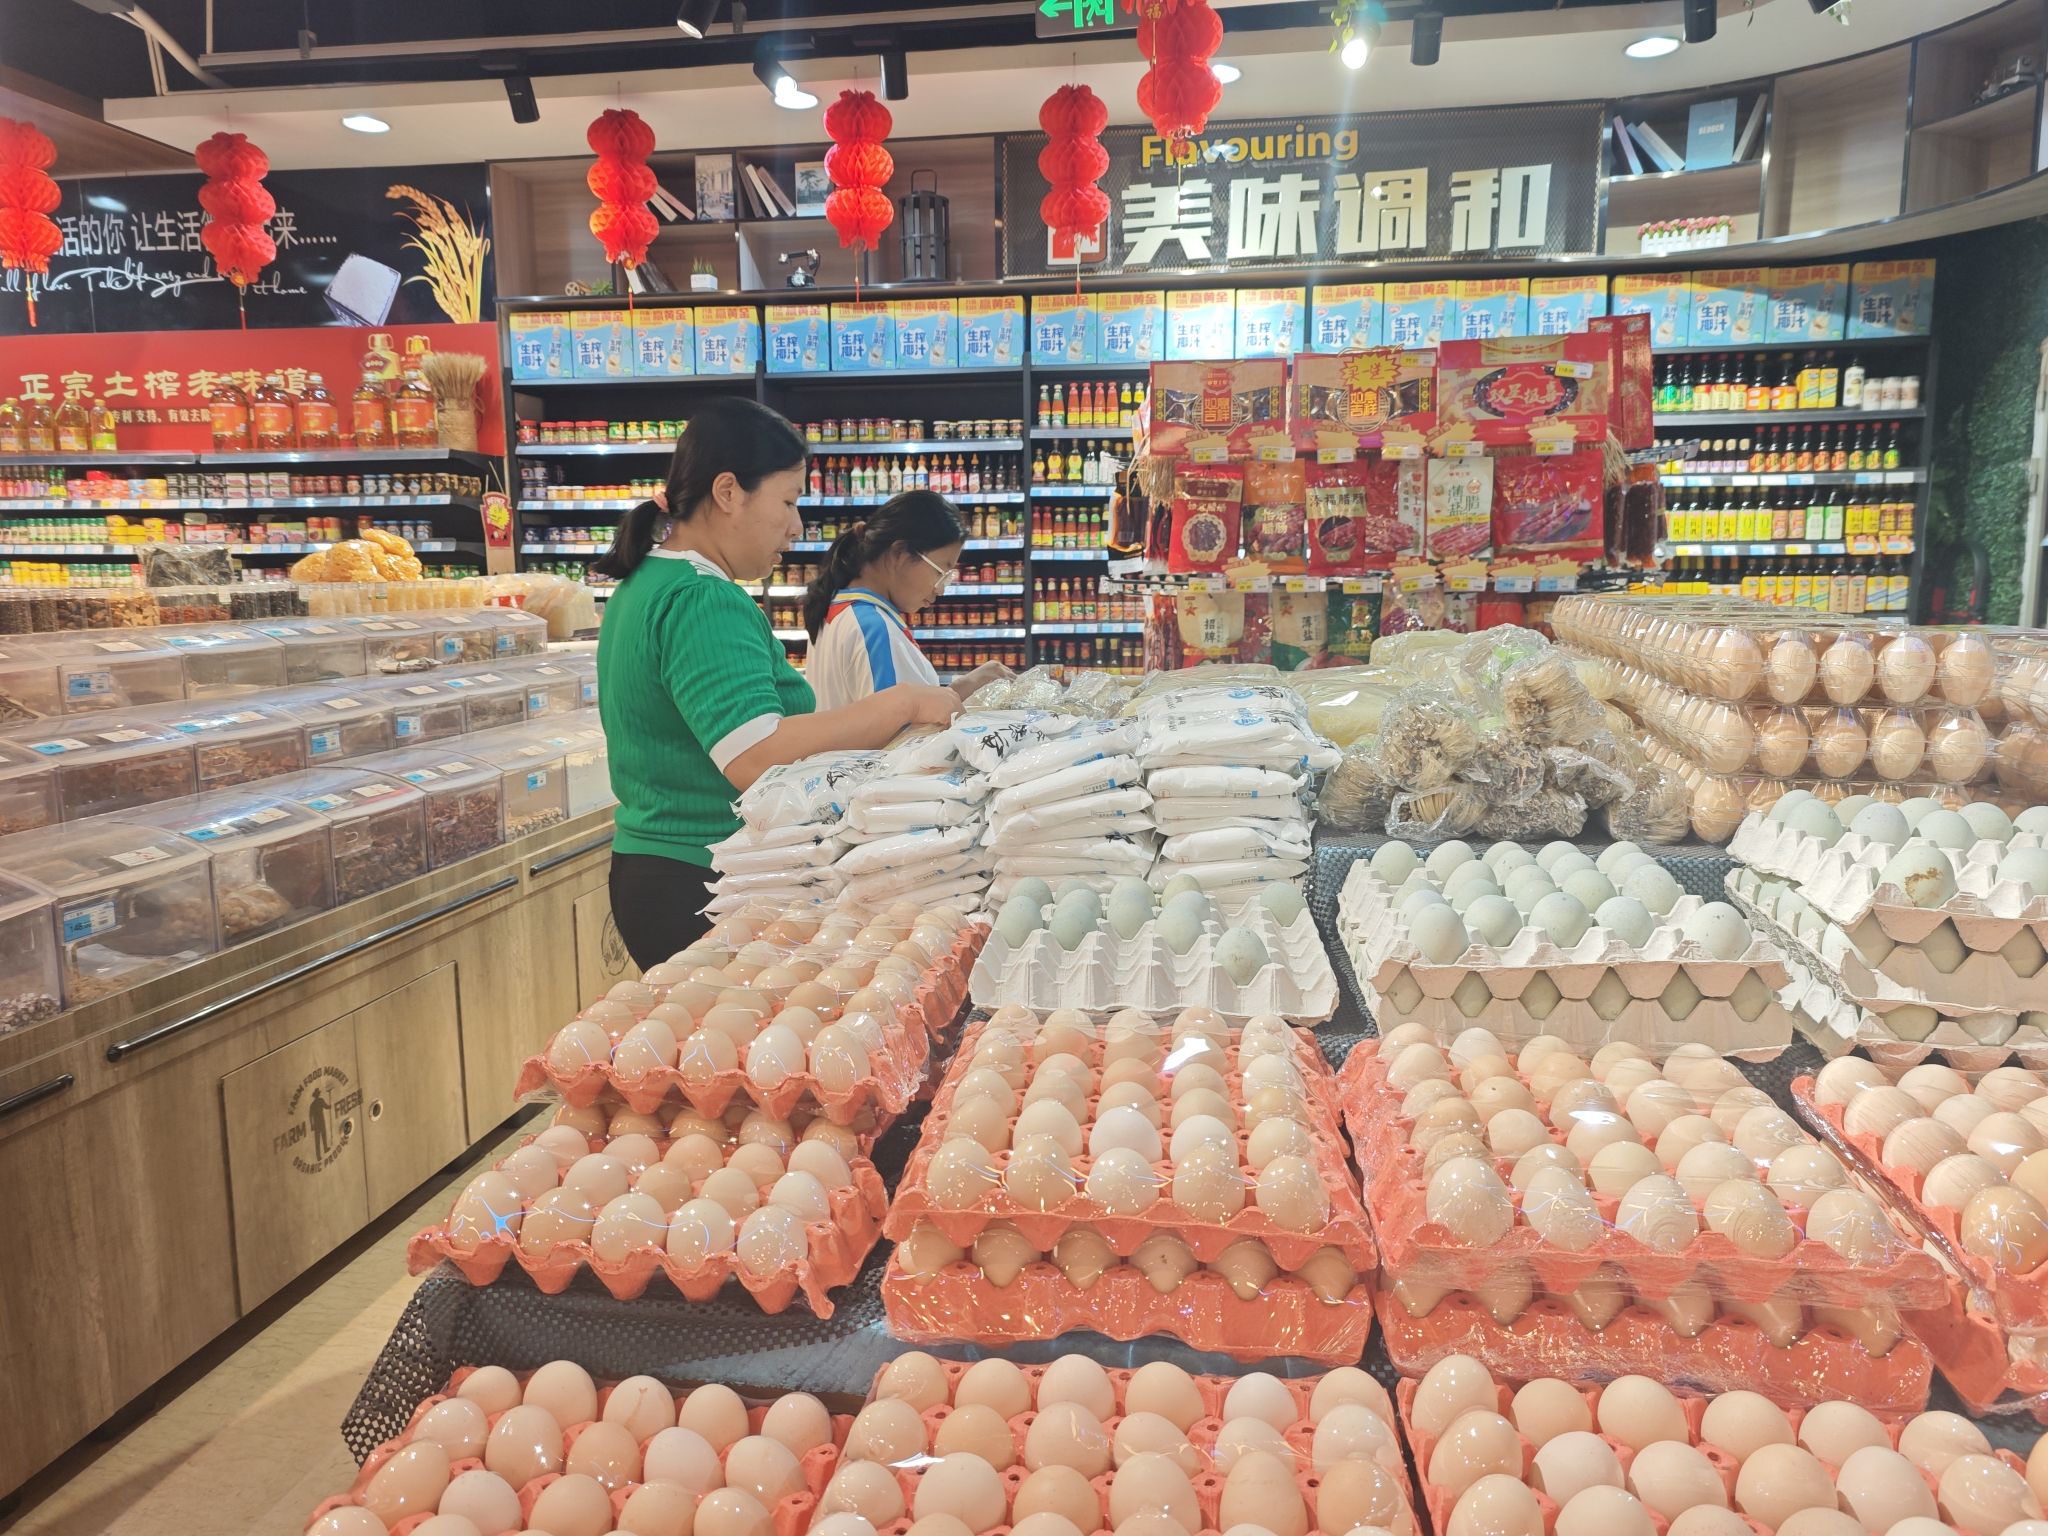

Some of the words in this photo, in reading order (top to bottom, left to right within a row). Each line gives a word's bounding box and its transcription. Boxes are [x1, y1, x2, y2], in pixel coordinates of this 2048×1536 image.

[1142, 124, 1359, 168] Flavouring
[1121, 163, 1552, 266] 美味调和
[288, 1084, 304, 1115] FARM
[303, 1068, 323, 1088] FOOD
[323, 1066, 349, 1086] MARKET
[273, 1121, 307, 1155] FARM
[334, 1088, 364, 1119] FRESH
[292, 1156, 323, 1174] ORGANIC
